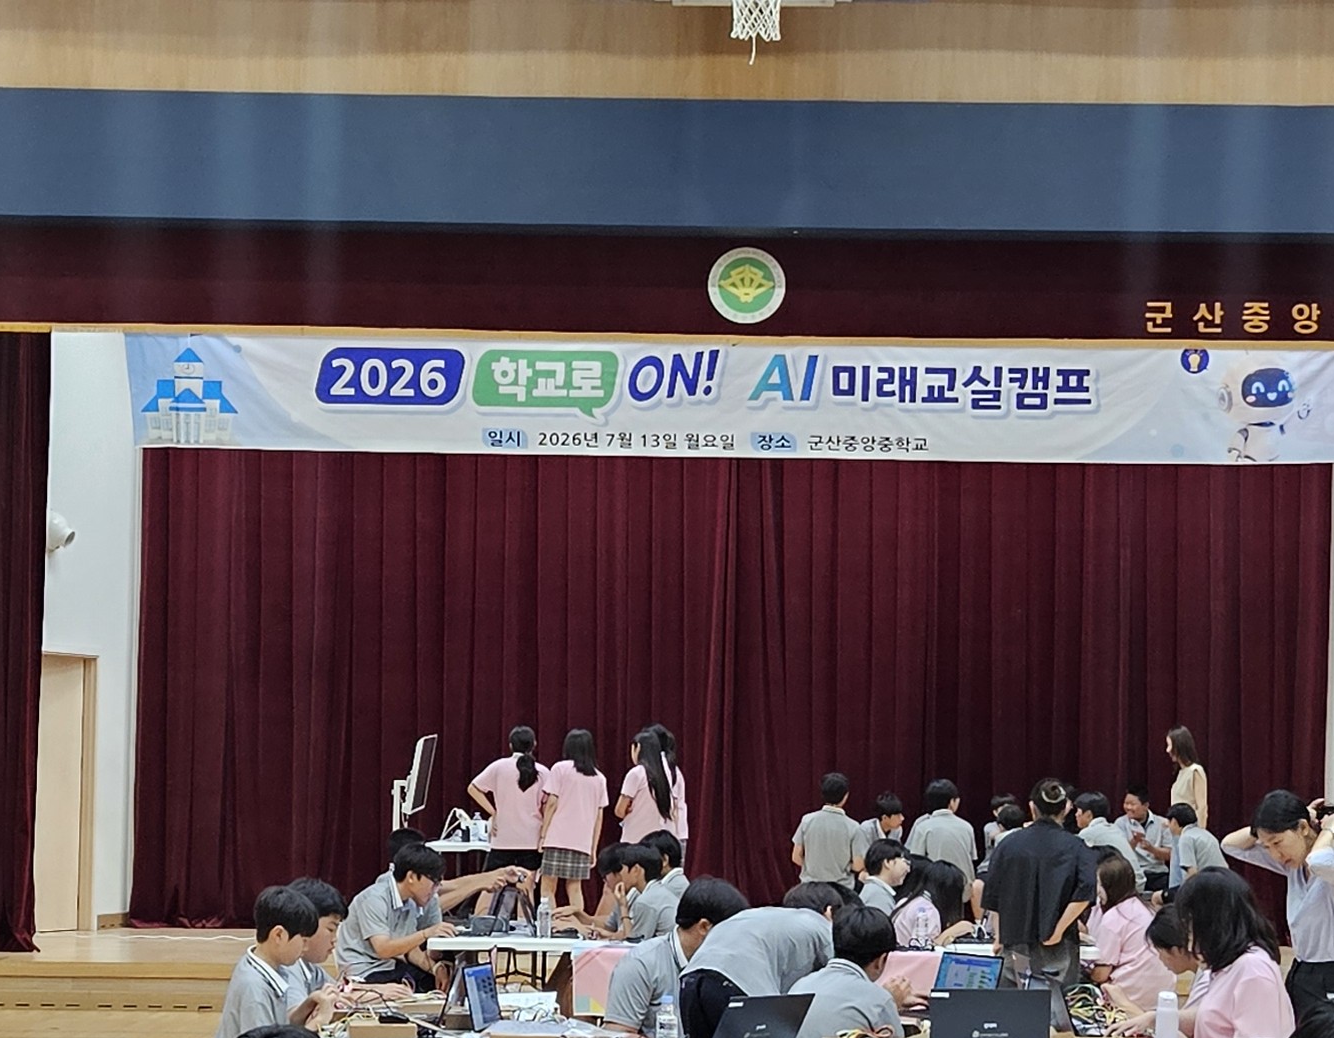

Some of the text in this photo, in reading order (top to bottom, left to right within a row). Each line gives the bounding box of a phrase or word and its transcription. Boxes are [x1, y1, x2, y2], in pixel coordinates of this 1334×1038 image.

[328, 348, 1093, 411] 2026 학교로 ON! AI 미래교실캠프
[487, 430, 930, 453] 일시 2026년 7월 13일 월요일 장소 군산중앙중학교
